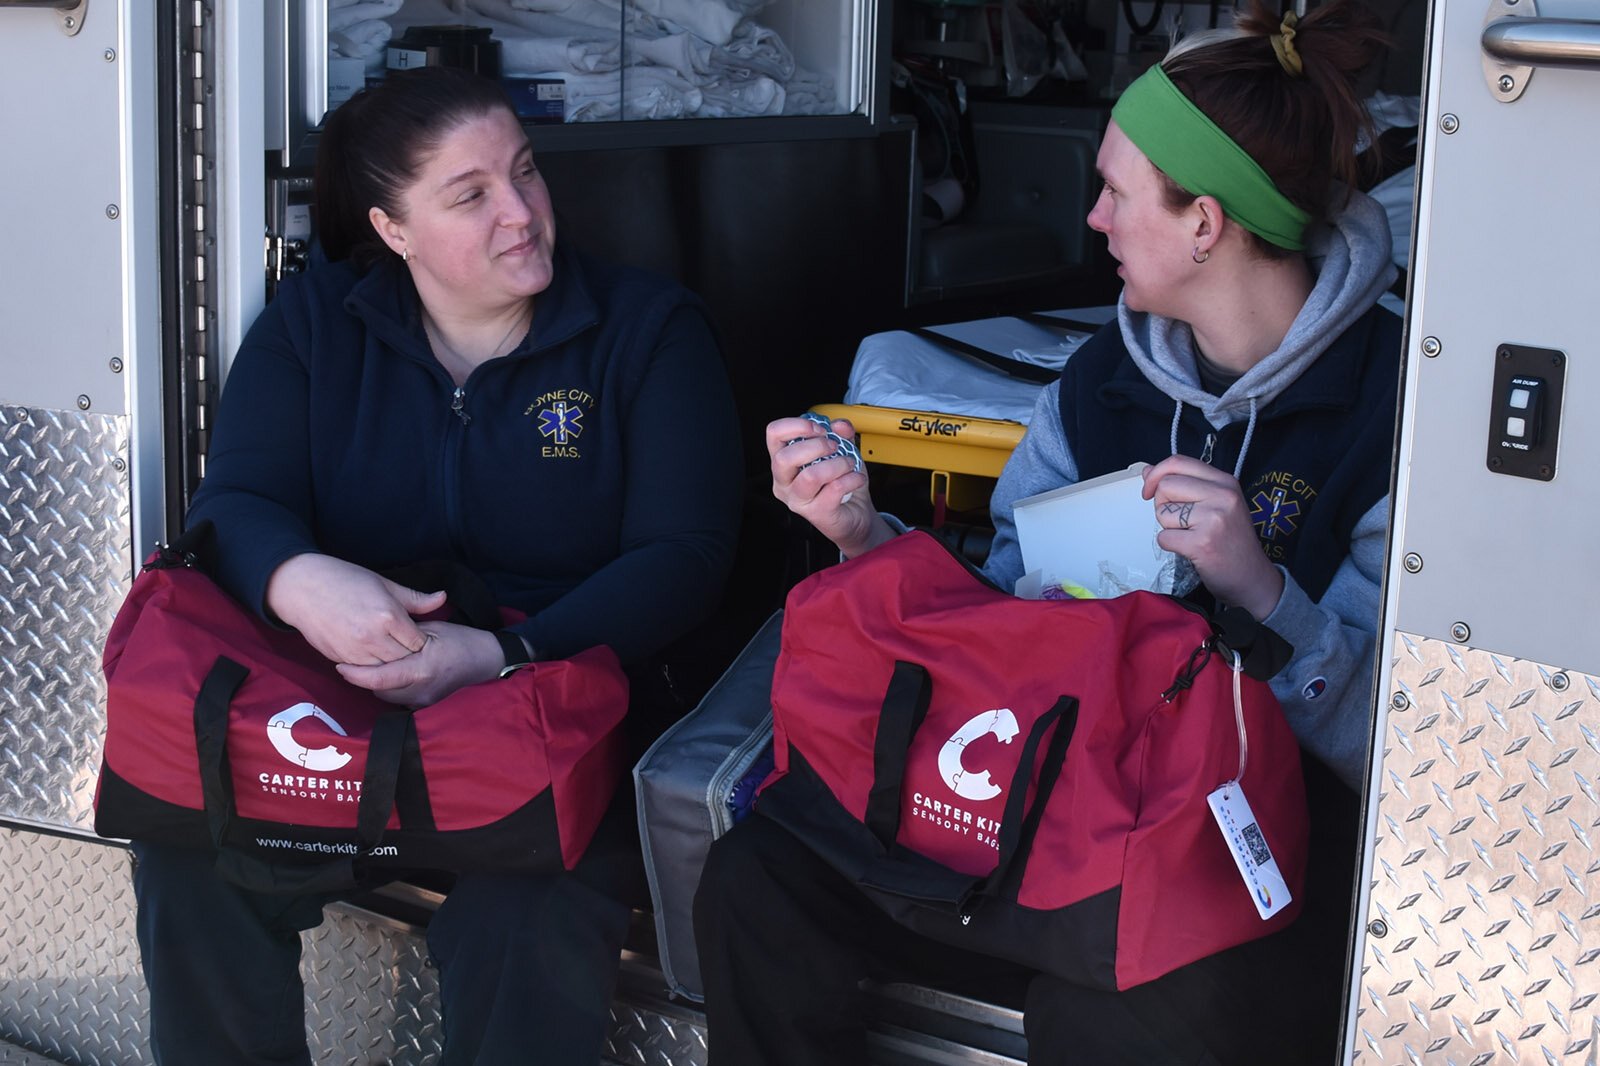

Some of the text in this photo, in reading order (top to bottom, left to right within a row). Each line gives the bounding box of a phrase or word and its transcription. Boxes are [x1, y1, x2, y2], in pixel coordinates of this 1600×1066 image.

[398, 51, 408, 67] H
[898, 416, 962, 437] stryker
[542, 446, 581, 458] E.M.S.
[1252, 472, 1318, 500] OYNE CIT
[259, 773, 362, 792] CARTER KIT
[262, 785, 361, 803] SENSORY BA
[913, 792, 1001, 835] CARTER KIT
[913, 807, 969, 835] SENSORY
[256, 837, 398, 856] www.carterkitsom
